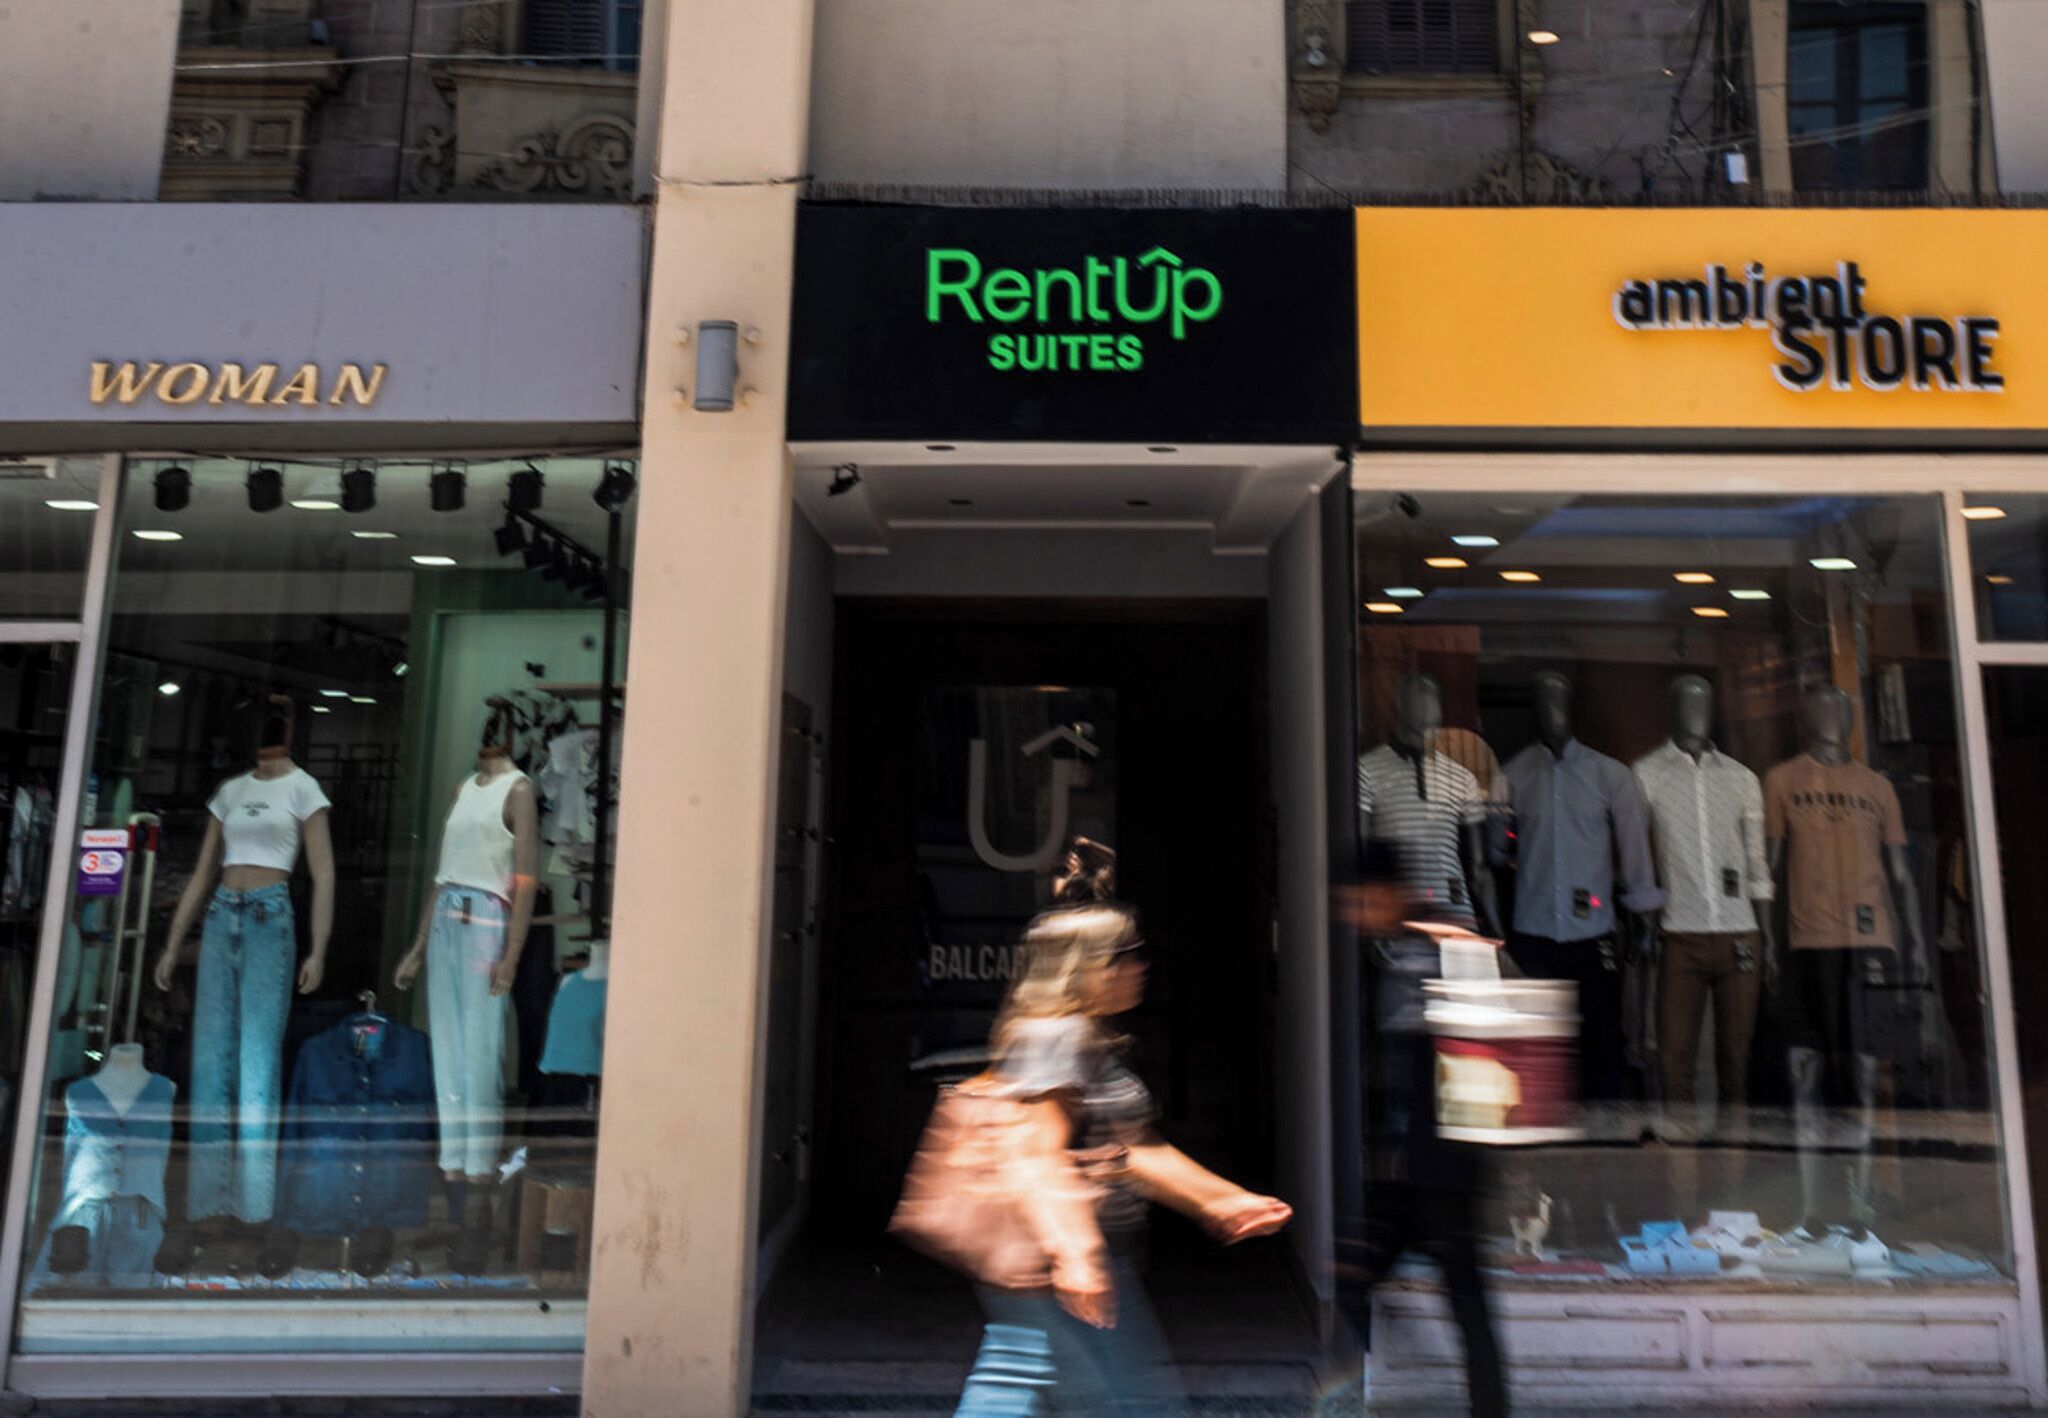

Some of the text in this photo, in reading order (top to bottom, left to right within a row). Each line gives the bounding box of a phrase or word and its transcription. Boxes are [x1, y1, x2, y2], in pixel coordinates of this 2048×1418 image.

[1613, 261, 1866, 331] ambient
[988, 334, 1144, 372] SUITES
[1771, 314, 2004, 392] STORE
[89, 361, 388, 405] WOMAN
[84, 852, 99, 872] 3
[929, 943, 1028, 980] BALCAR
